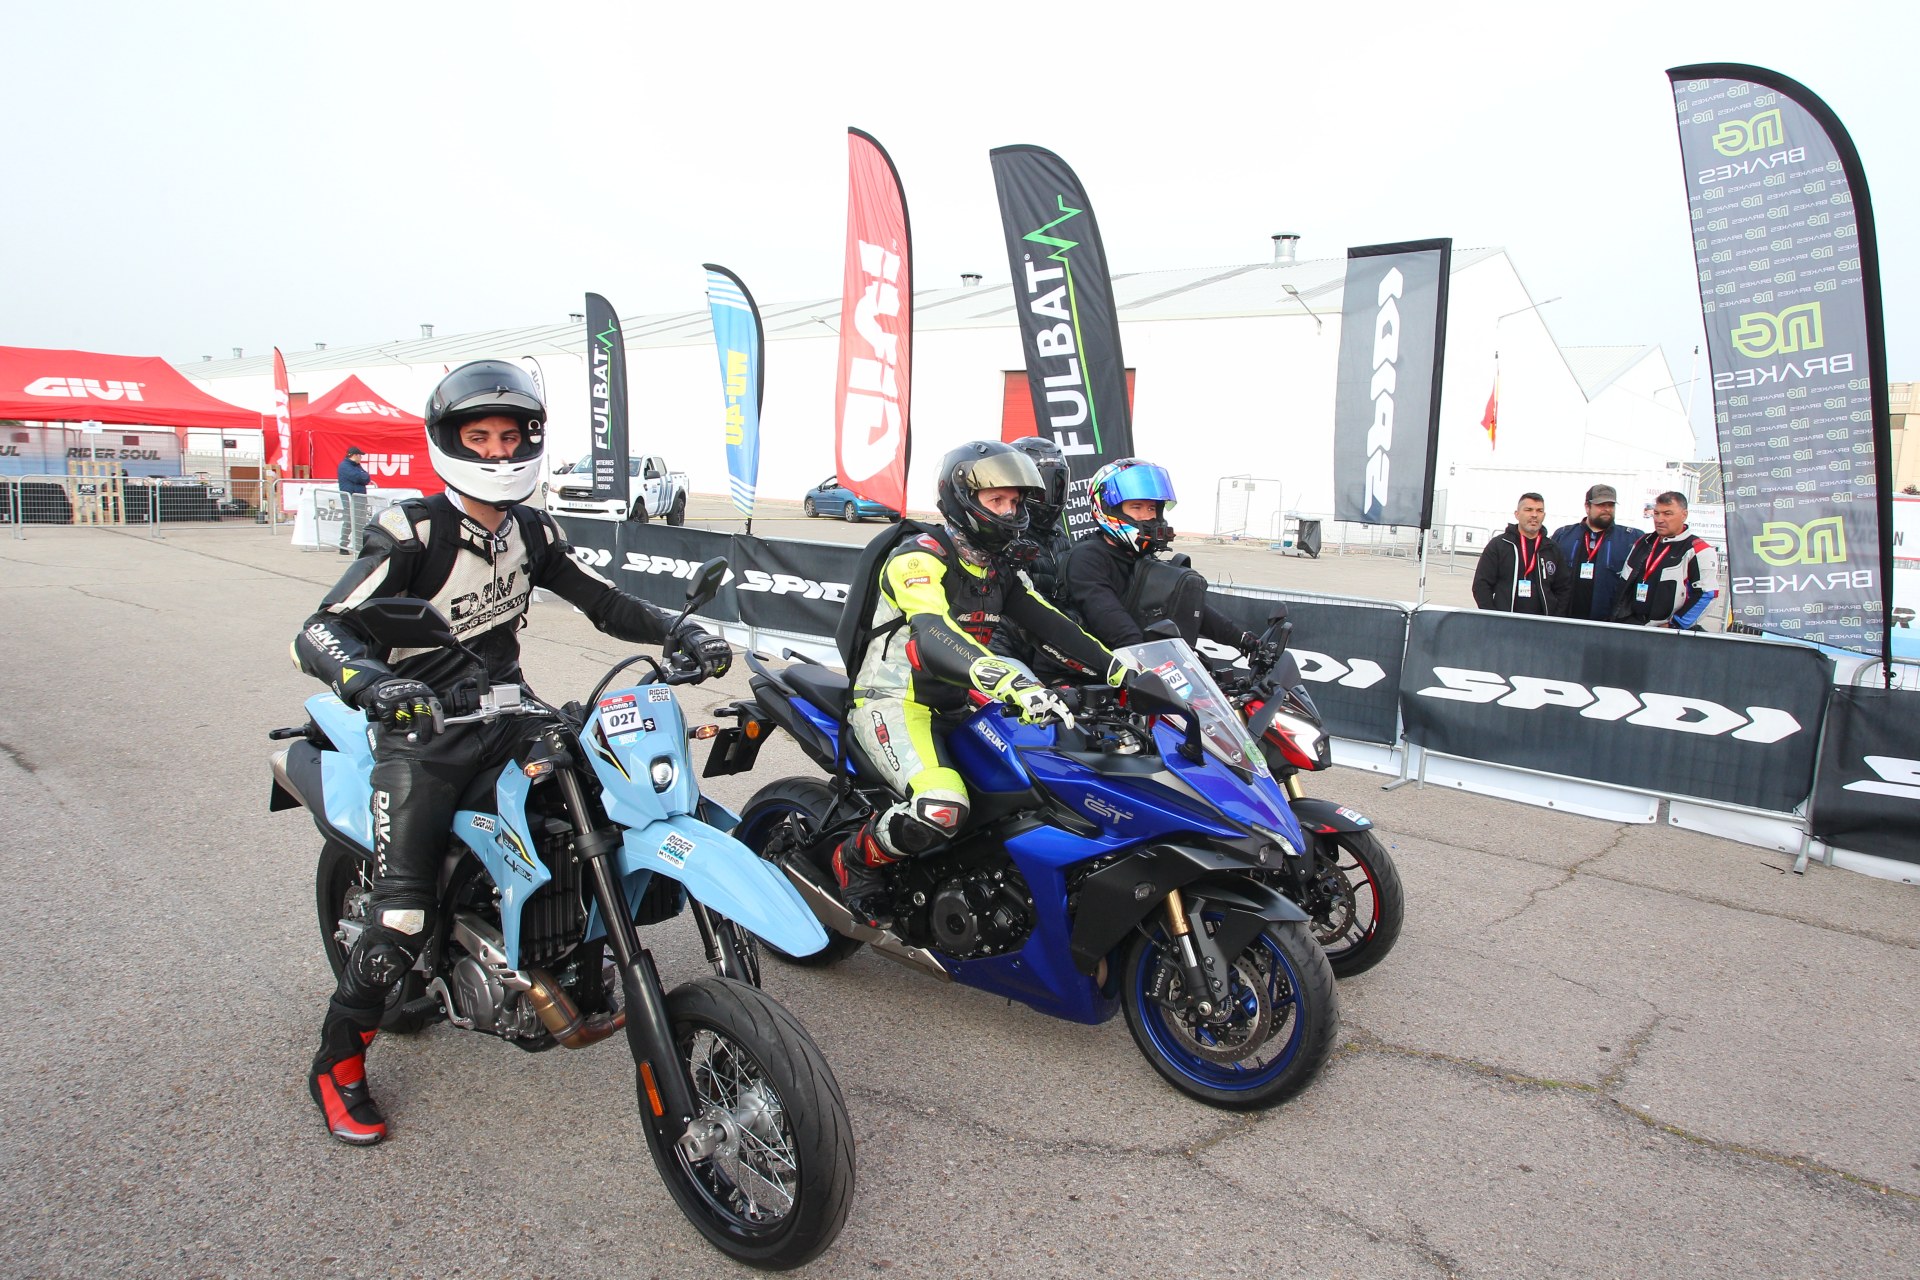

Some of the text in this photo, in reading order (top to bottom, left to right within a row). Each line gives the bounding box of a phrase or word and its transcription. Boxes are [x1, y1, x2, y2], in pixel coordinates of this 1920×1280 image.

[1025, 260, 1096, 457] FULBAT
[23, 377, 145, 401] GIVI
[593, 347, 609, 449] FULBAT
[335, 400, 401, 418] GIVI
[66, 447, 161, 461] RIDER SOUL
[314, 508, 344, 521] RID
[451, 571, 516, 621] DAV
[736, 569, 853, 603] SPID
[308, 623, 341, 648] DAV
[943, 637, 955, 647] ET
[1416, 666, 1802, 744] SPIDI
[609, 711, 636, 727] 027
[976, 721, 1008, 753] SUZUKI
[379, 790, 391, 843] DAV
[663, 842, 685, 860] SOUL
[667, 834, 694, 852] RIDER
[1152, 968, 1165, 997] brembo
